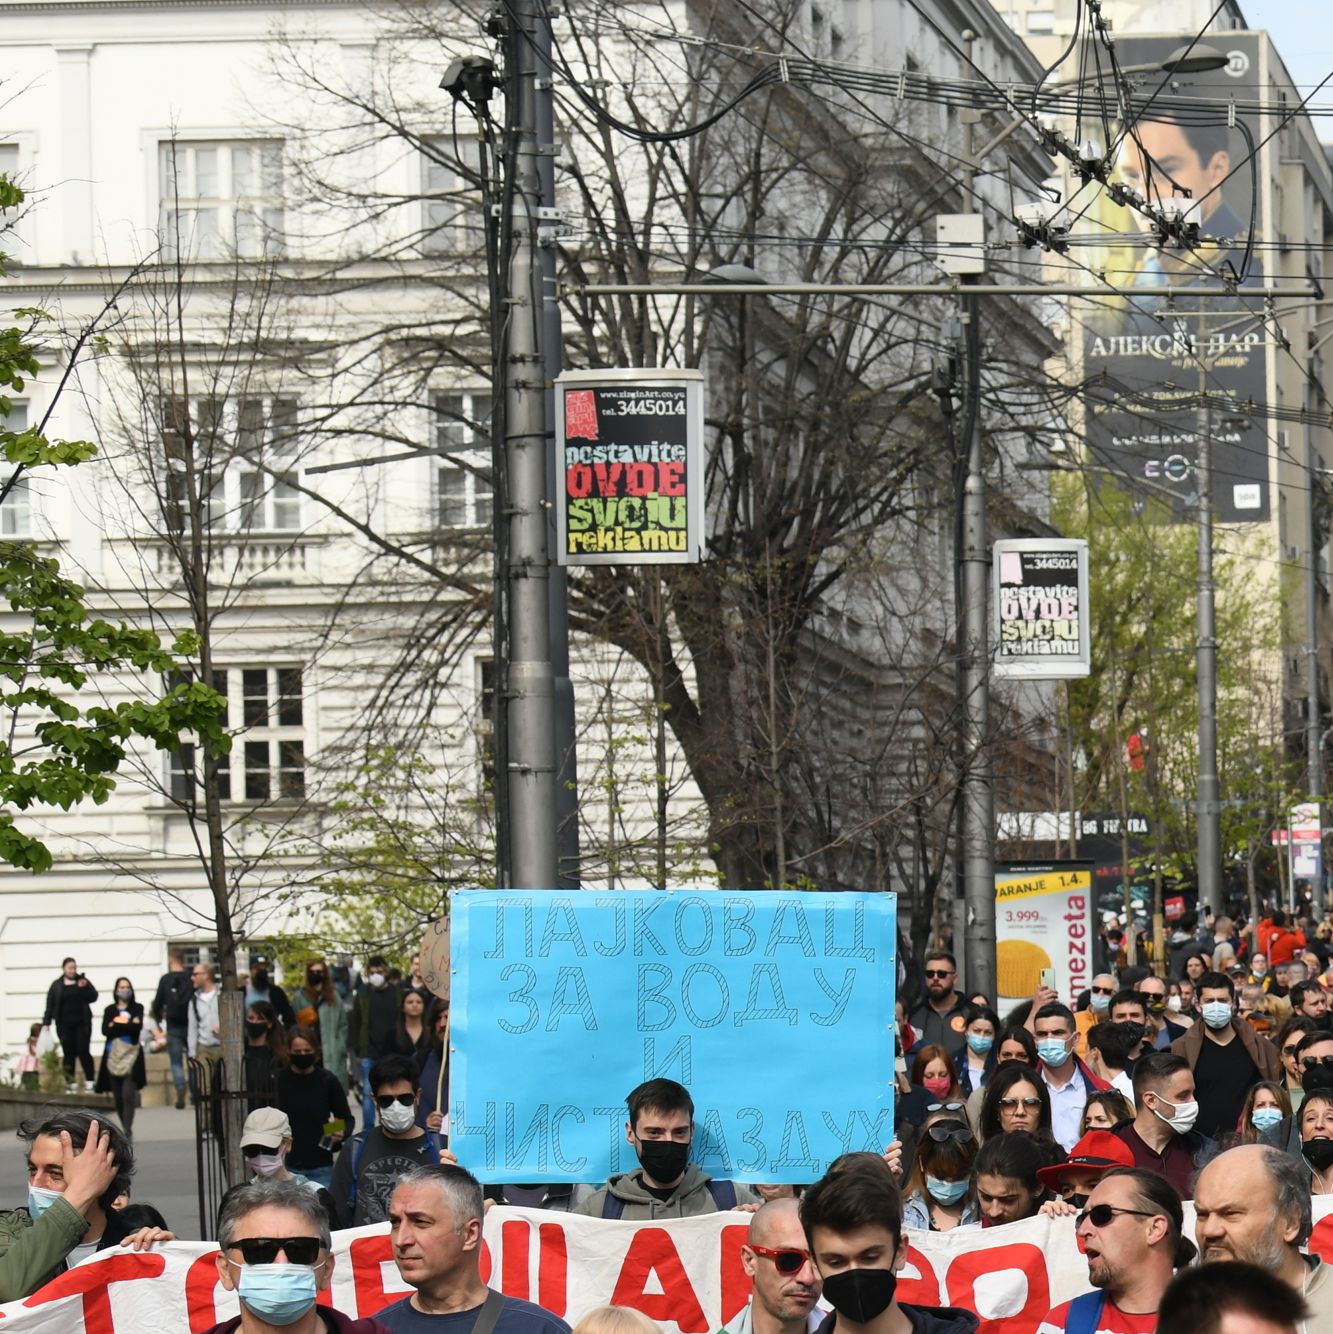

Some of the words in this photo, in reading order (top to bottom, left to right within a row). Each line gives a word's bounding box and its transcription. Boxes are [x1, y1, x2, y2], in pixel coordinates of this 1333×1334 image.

[618, 400, 685, 416] 3445014
[566, 441, 686, 467] postavite
[567, 462, 686, 498] OVDE
[568, 492, 686, 530] svoju
[568, 526, 687, 553] reklamu
[1034, 559, 1077, 569] 3445014
[1001, 638, 1079, 655] reklamu
[1058, 873, 1082, 887] 1.4.
[483, 896, 875, 964] ЛАЈКОВАЦ
[1005, 911, 1039, 922] 3.999
[497, 962, 599, 1034] ЗА
[637, 962, 856, 1032] ВОДУ
[643, 1035, 692, 1086] И
[690, 1107, 890, 1173] АЗДУХ
